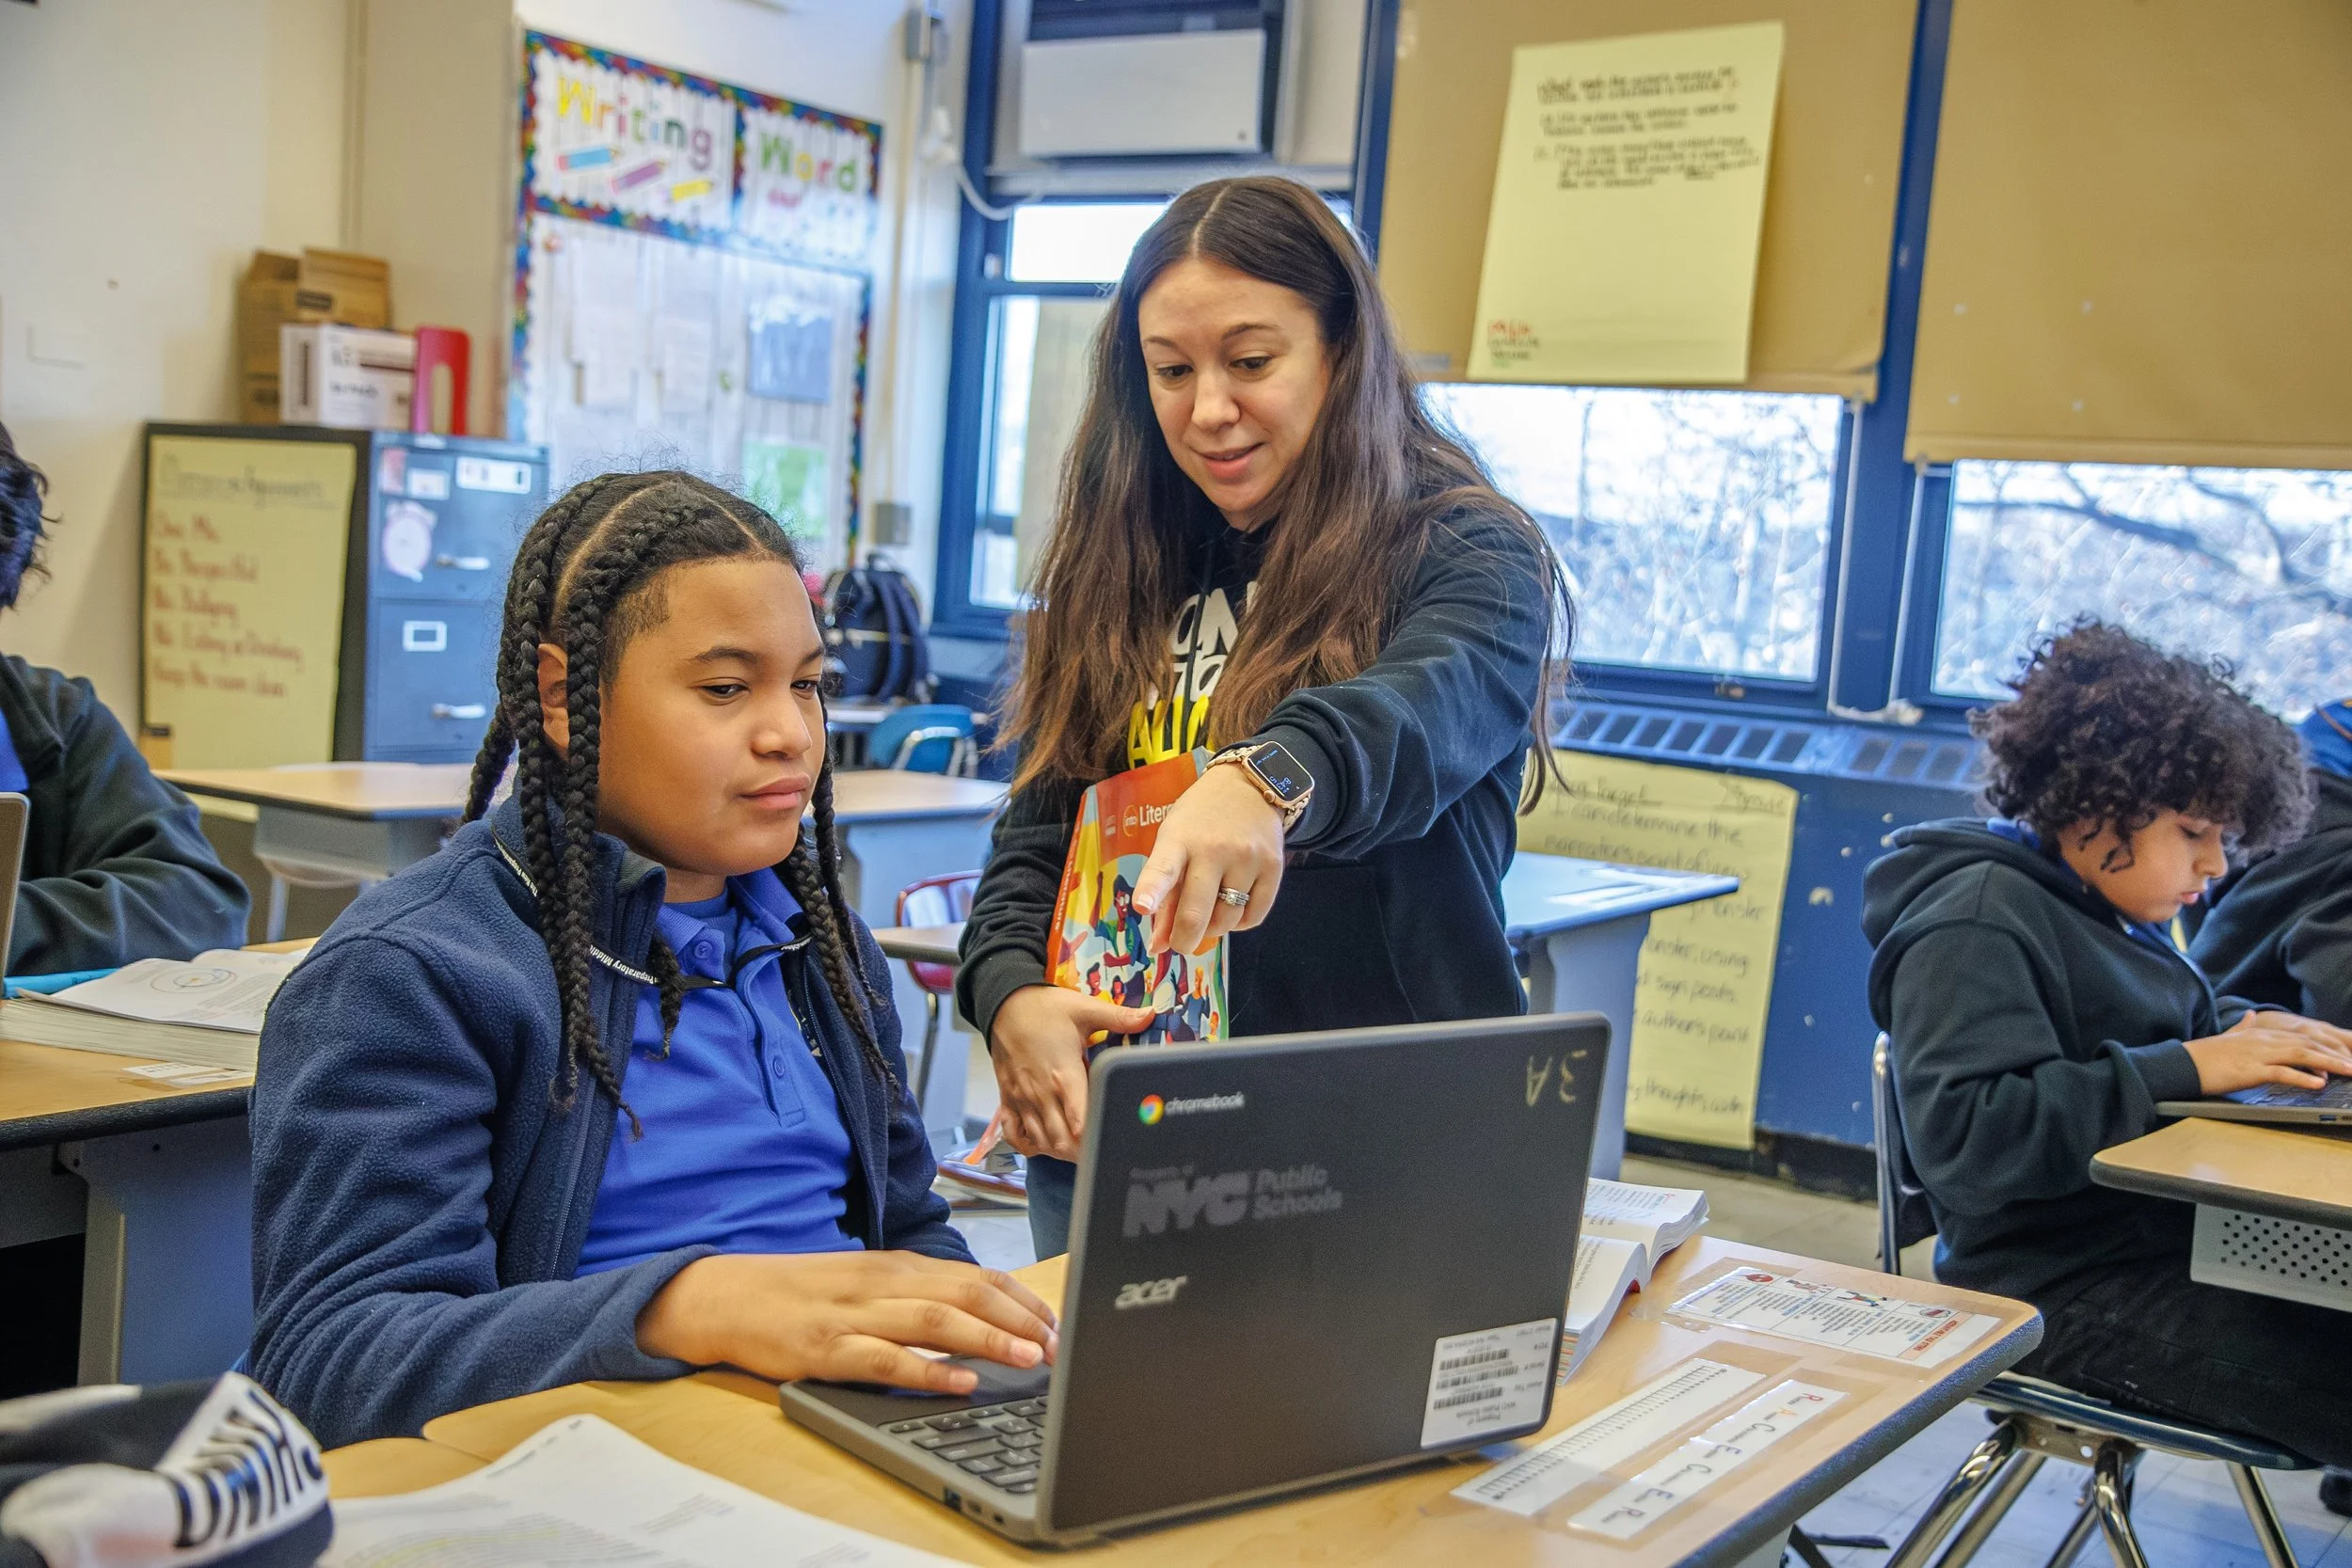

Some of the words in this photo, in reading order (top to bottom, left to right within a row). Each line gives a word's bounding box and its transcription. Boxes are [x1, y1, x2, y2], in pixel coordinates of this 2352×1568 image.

[557, 76, 712, 172] Writing
[761, 131, 857, 192] Word
[612, 959, 654, 985] Preparatory
[1164, 1091, 1245, 1116] chromebook
[1257, 1163, 1327, 1190] Public
[1122, 1171, 1249, 1238] NYC
[1253, 1185, 1343, 1220] Schools
[1115, 1275, 1188, 1309] acer
